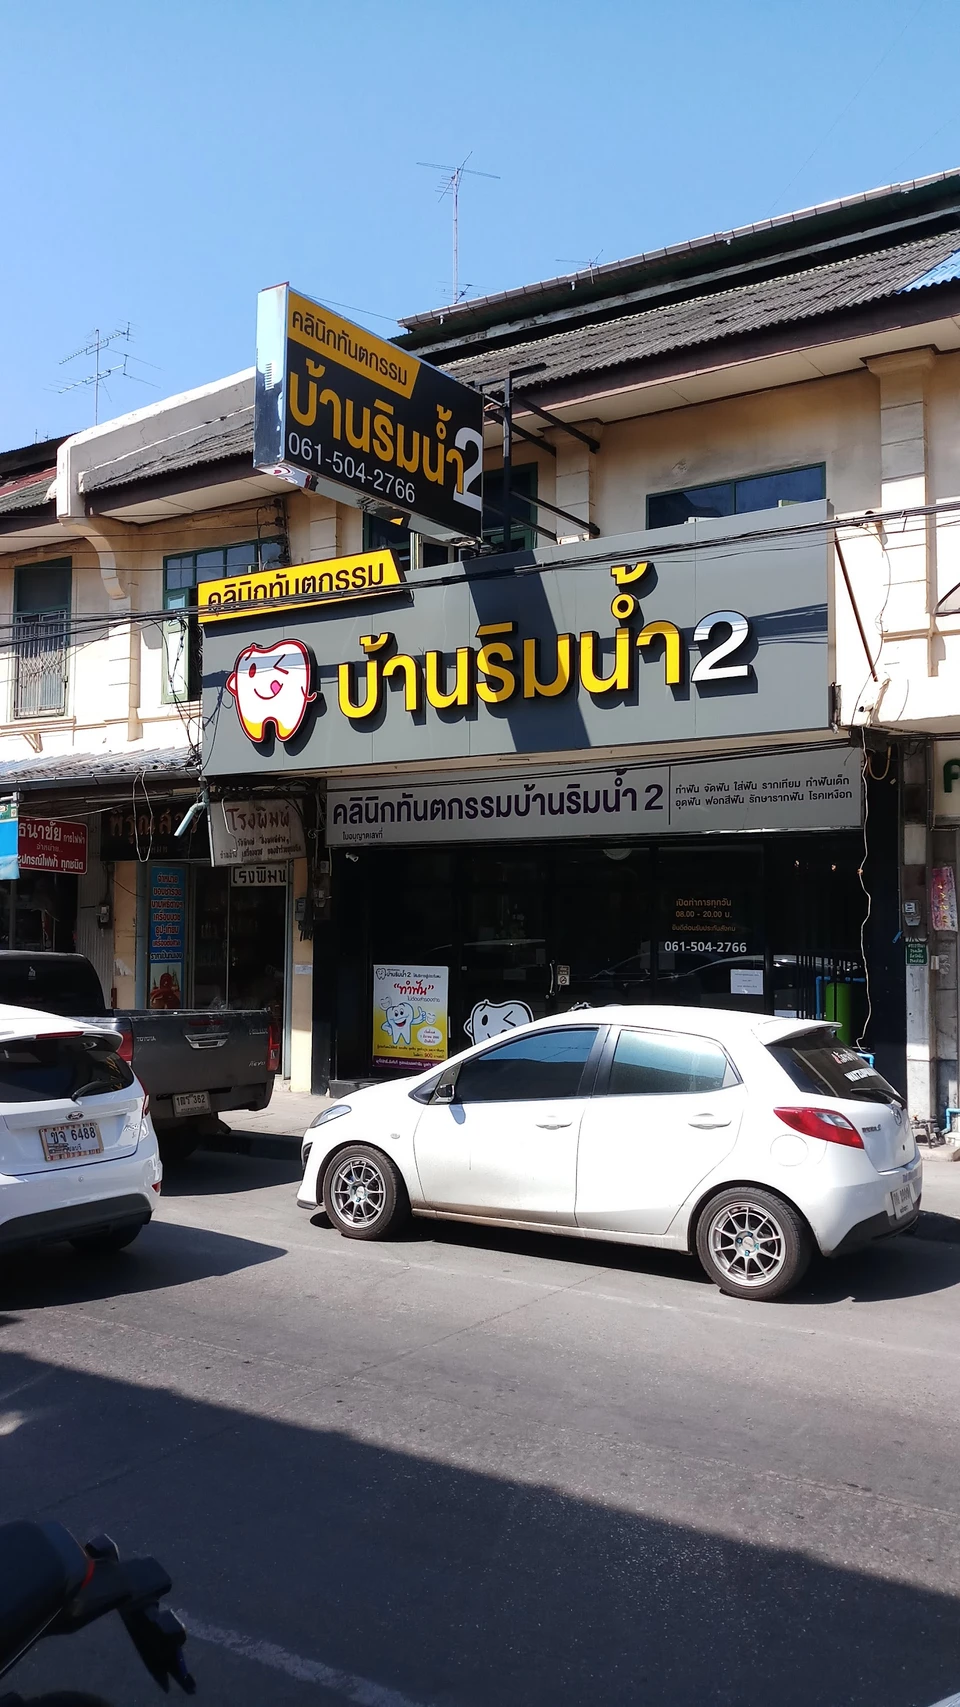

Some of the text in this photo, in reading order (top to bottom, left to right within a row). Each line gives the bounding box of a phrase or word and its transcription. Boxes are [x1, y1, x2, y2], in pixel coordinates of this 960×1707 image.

[292, 310, 408, 386] คลินิกทันตกรรม
[289, 432, 416, 503] 061-504-2766
[675, 774, 850, 795] ทำฟัน จัดฟัน ใส่ฟัน รากเทียม ทำฟันเด็ก
[644, 784, 664, 811] 2
[675, 788, 853, 809] อุดฟัน ฟอกสีฟัน รักษารากฟัน โรคเหงือก
[225, 805, 290, 831] โรงพิมพ์
[63, 831, 86, 844] การไฟฟ้า
[61, 859, 84, 871] ทุกชนิด
[676, 898, 732, 908] เปิดทำการทุกวัน
[675, 910, 695, 918] 08.00
[664, 941, 747, 953] 061-504-2766
[193, 1094, 206, 1105] 362
[71, 1127, 96, 1141] 6488
